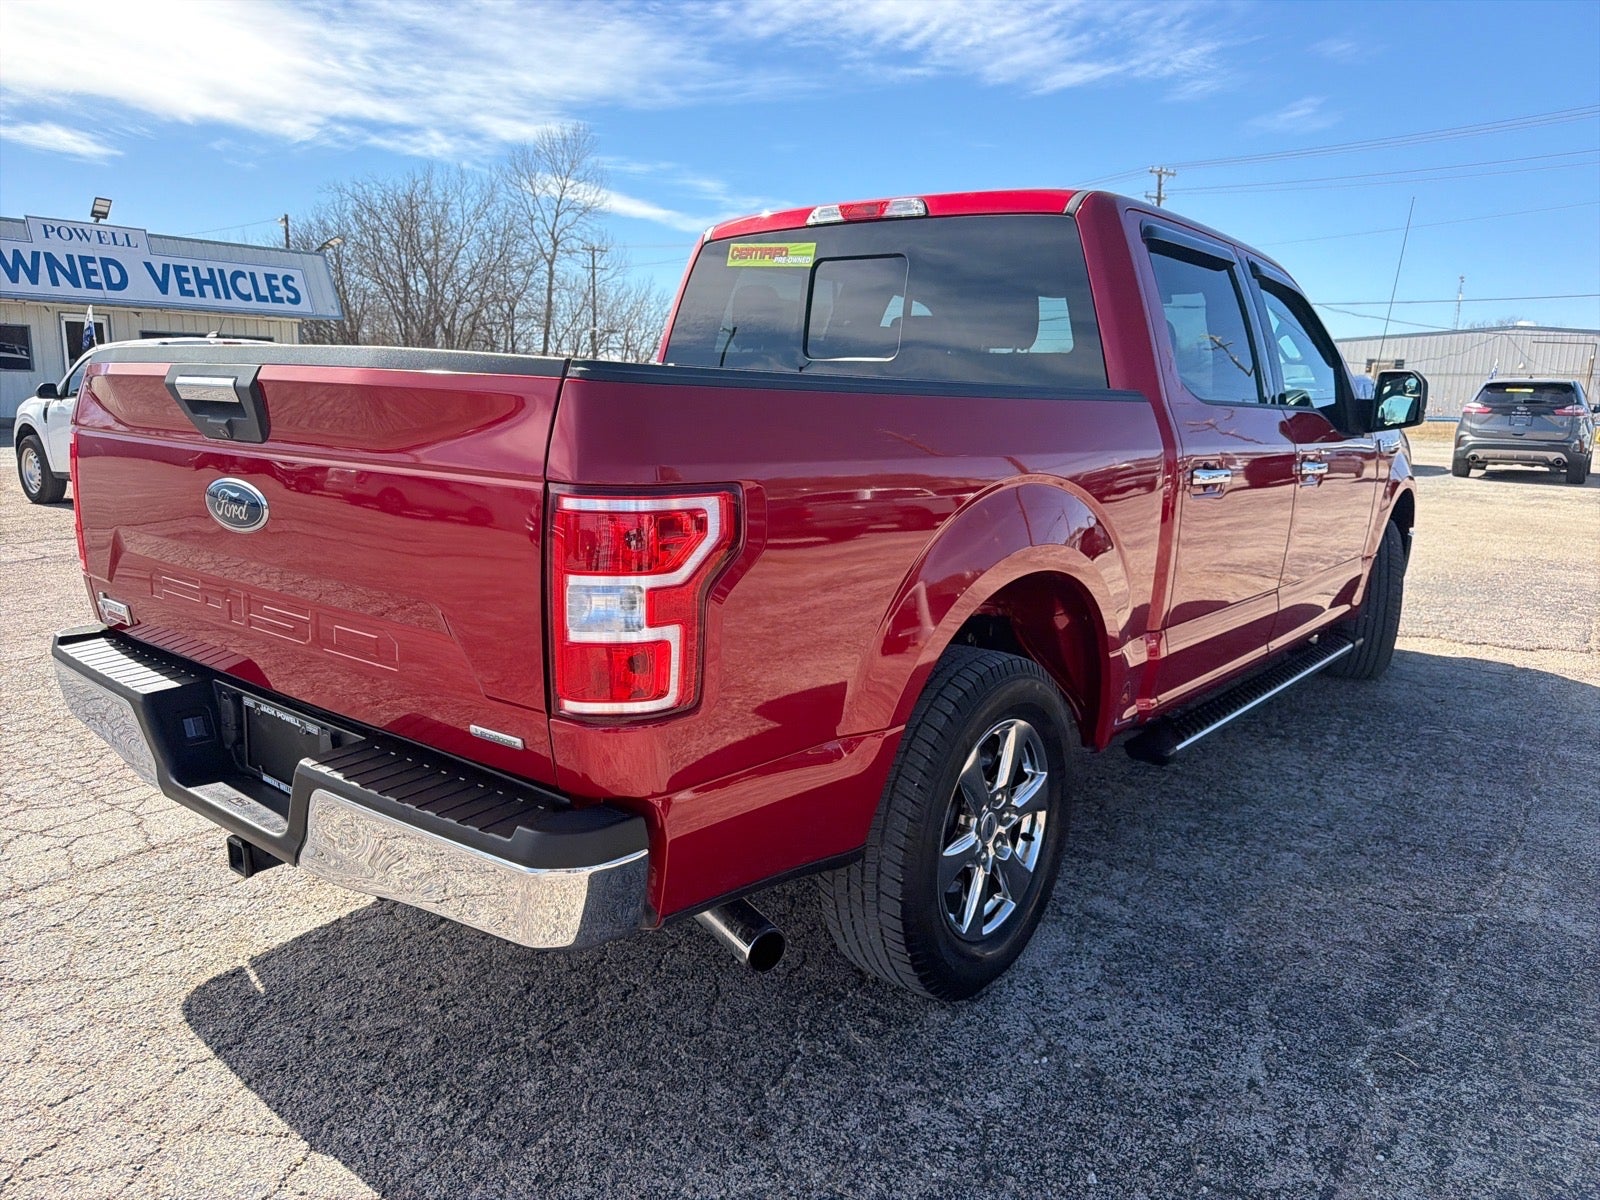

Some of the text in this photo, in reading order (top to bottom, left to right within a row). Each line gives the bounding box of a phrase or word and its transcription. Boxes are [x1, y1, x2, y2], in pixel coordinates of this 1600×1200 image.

[42, 223, 139, 249] POWELL
[730, 246, 789, 260] CERTIFIED
[773, 256, 811, 264] PRE-OWNED
[142, 261, 302, 306] VEHICLES
[215, 488, 249, 521] Ford
[150, 566, 400, 672] F-150
[260, 703, 302, 728] JACK POWELL
